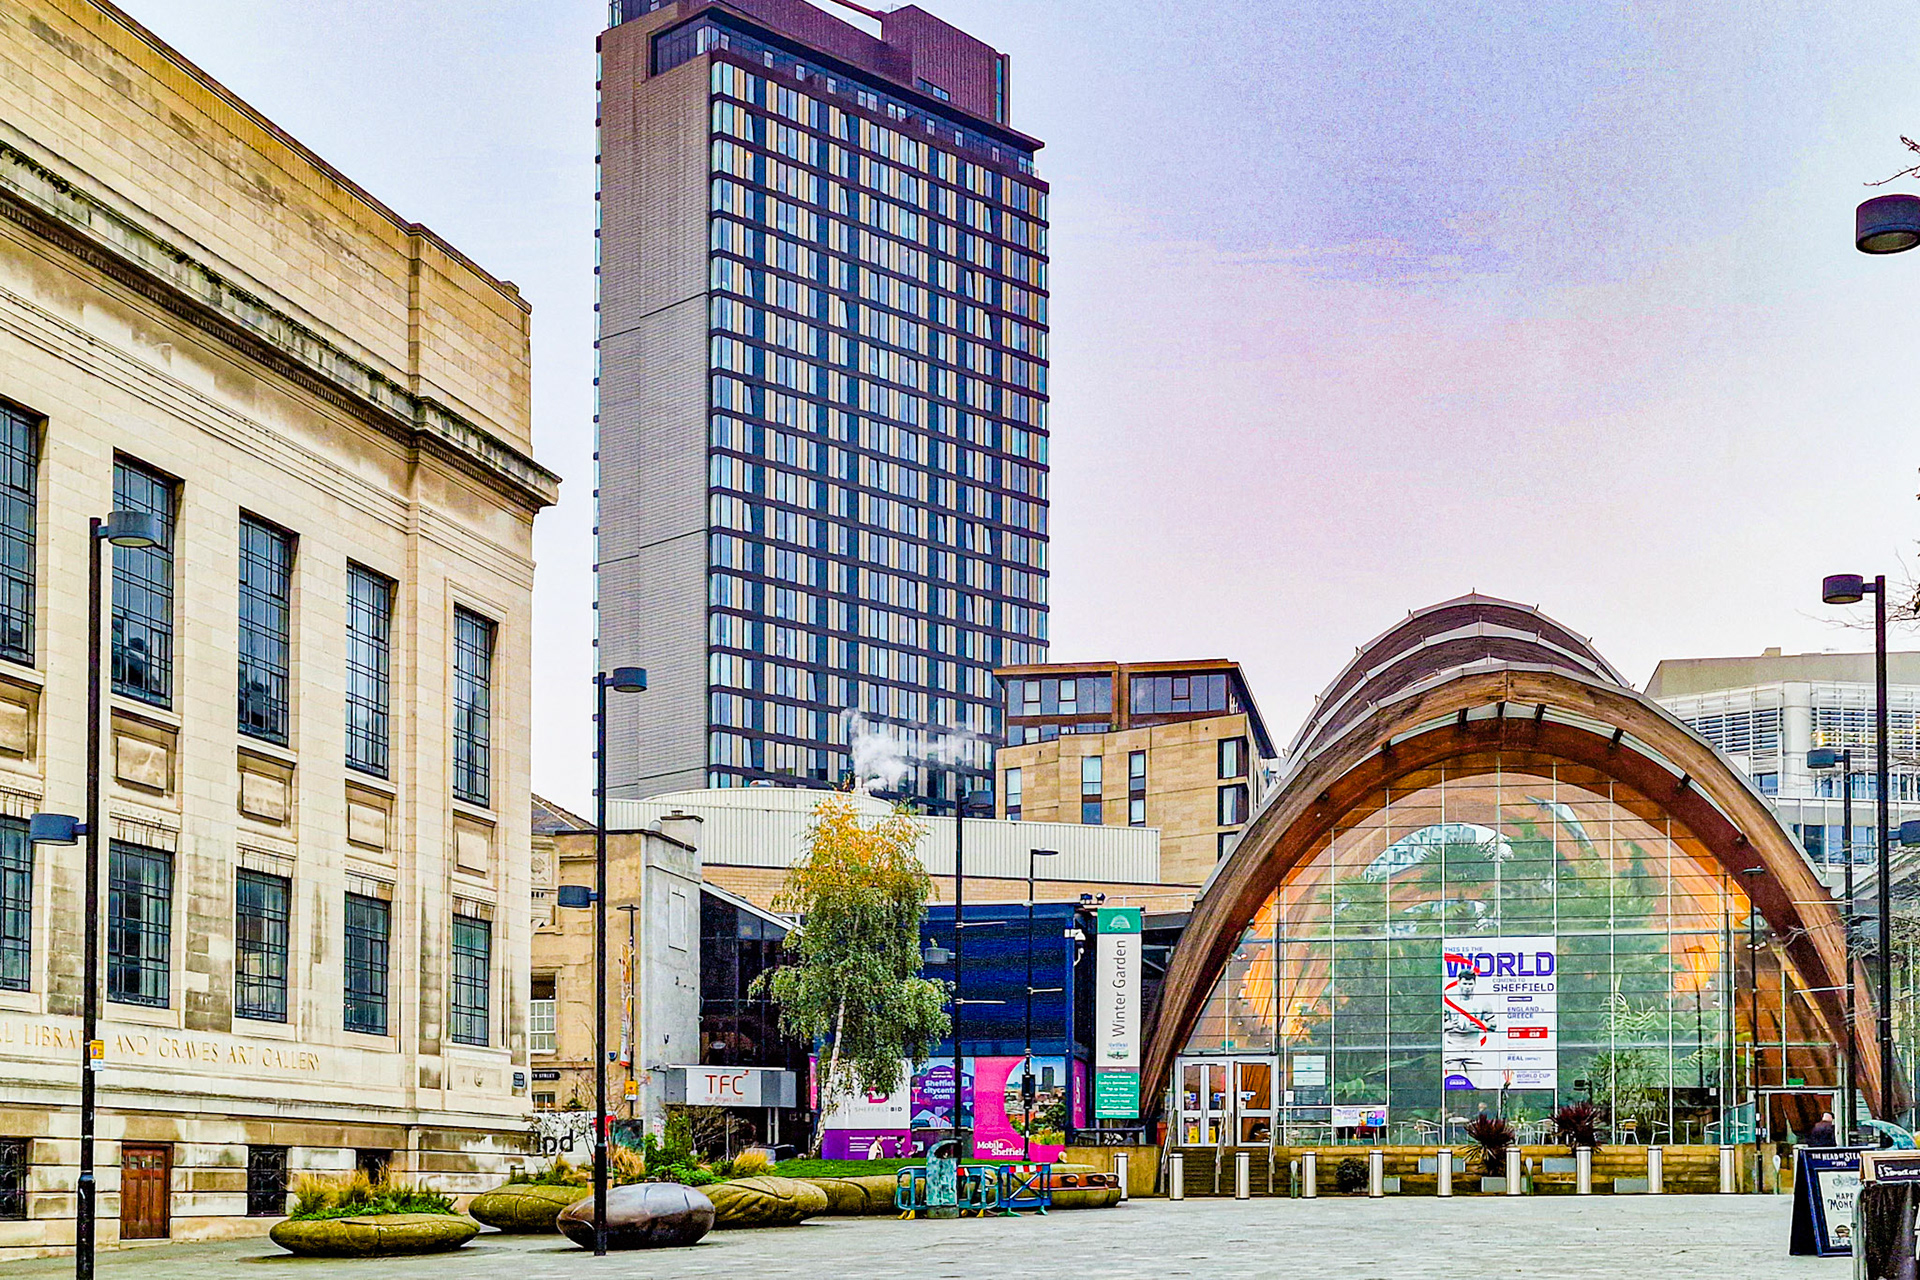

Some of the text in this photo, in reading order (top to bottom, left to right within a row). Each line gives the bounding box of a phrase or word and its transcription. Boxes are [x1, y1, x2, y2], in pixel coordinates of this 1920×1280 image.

[1444, 952, 1554, 977] WORLD
[1112, 940, 1126, 1037] Winter Garden
[1493, 983, 1554, 992] SHEFFIELD
[24, 1023, 90, 1049] LIBRA
[113, 1034, 149, 1056] AND
[158, 1037, 219, 1063] GRAVES
[227, 1045, 254, 1065] ART
[262, 1048, 320, 1071] GALLERY
[705, 1075, 744, 1095] TFC
[977, 1141, 1004, 1150] Mobile
[1822, 1153, 1838, 1161] HEAD
[1845, 1152, 1861, 1162] STEA
